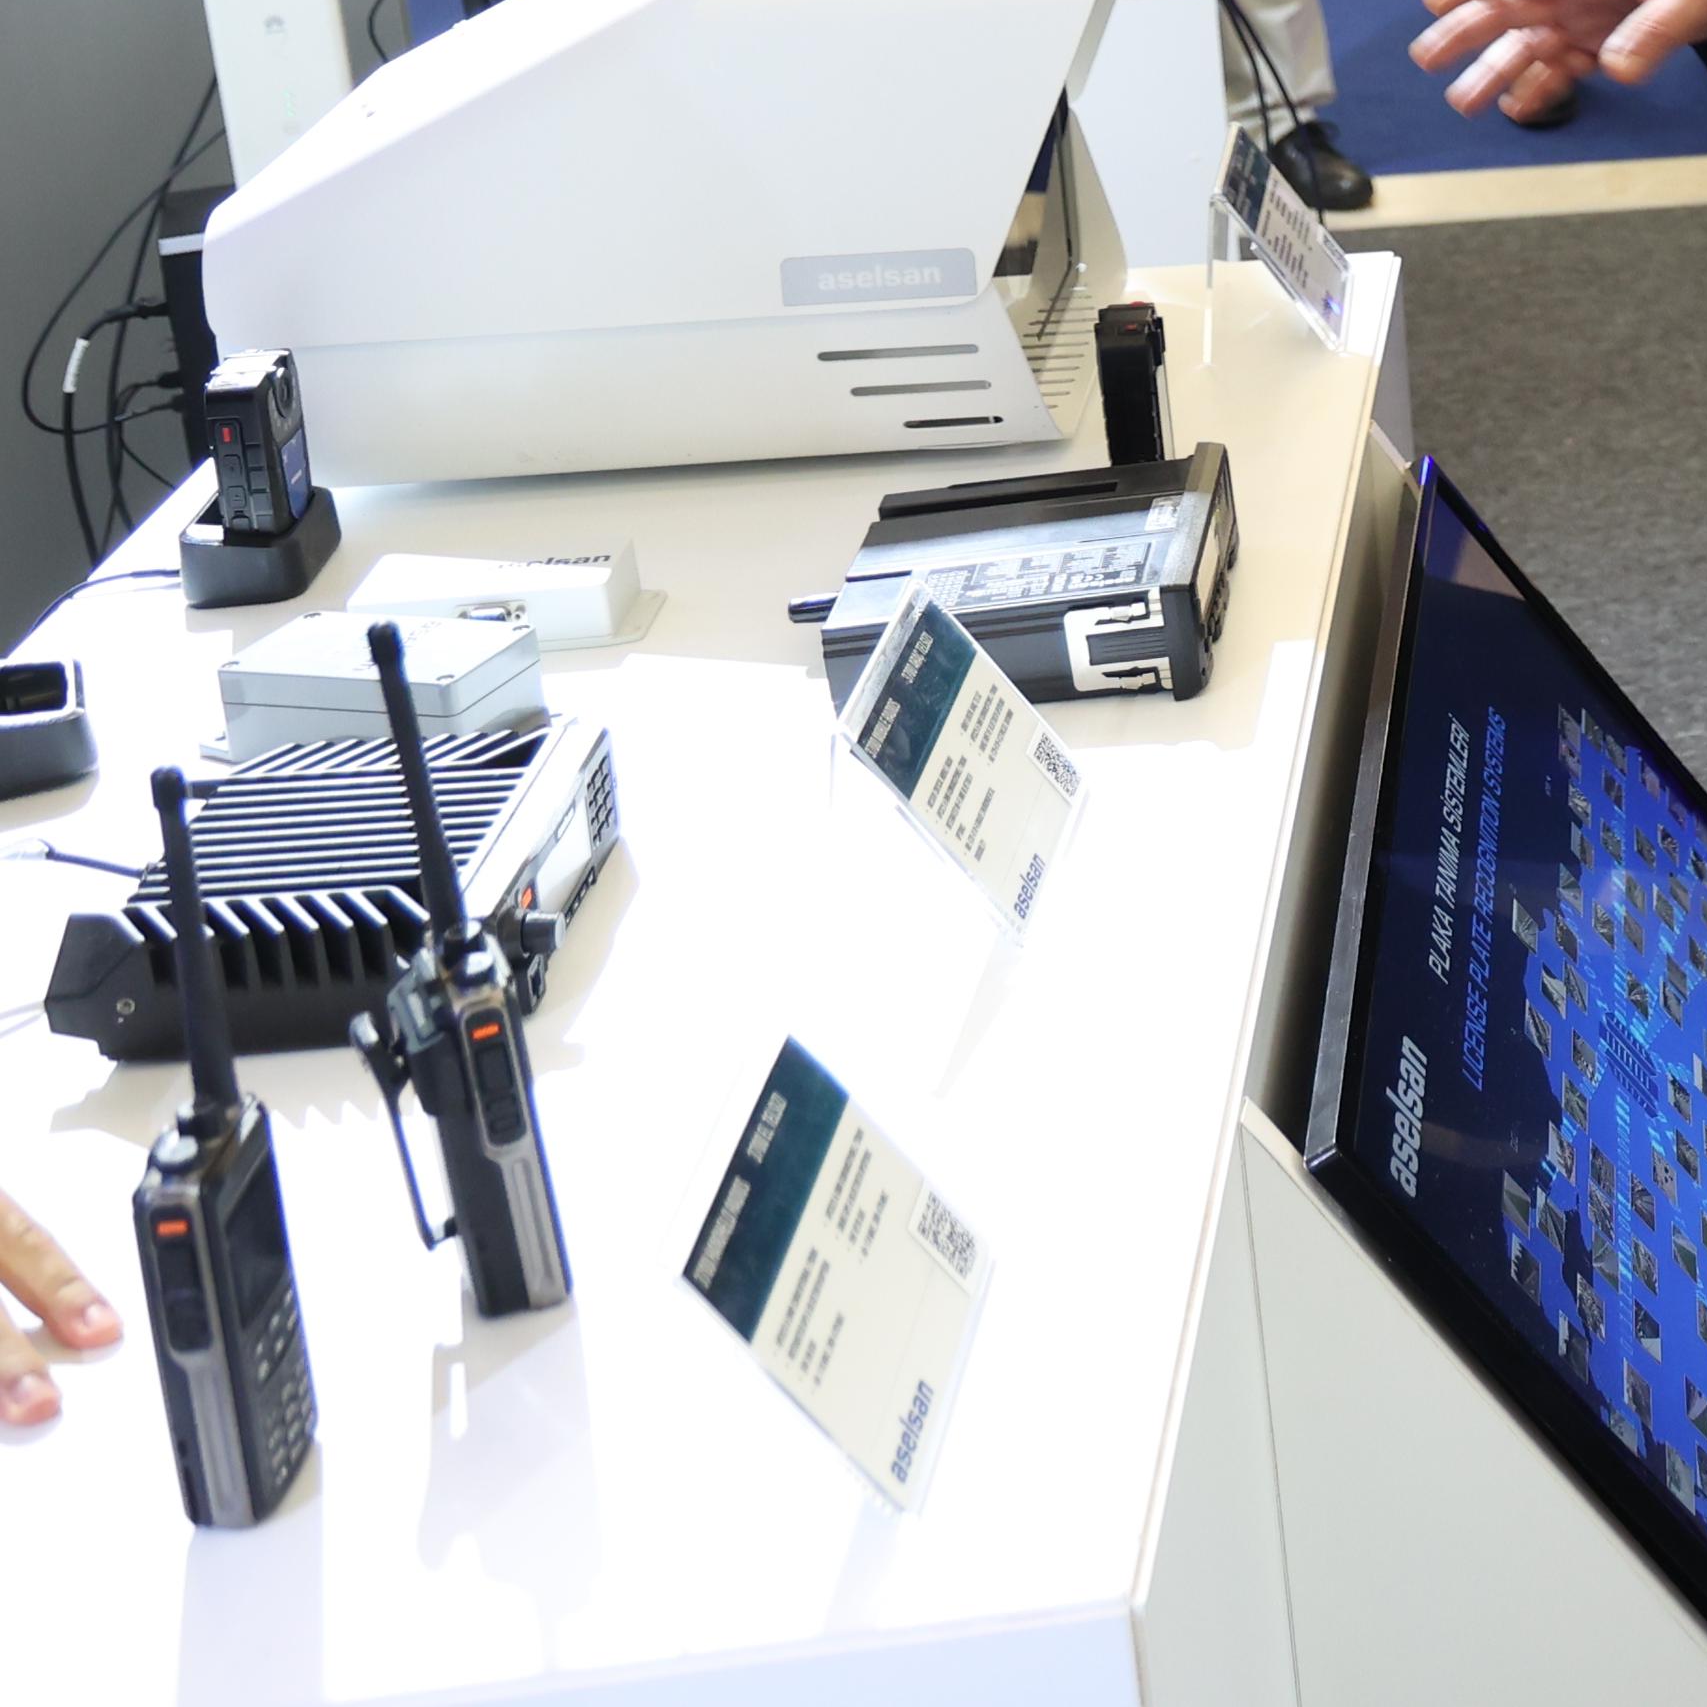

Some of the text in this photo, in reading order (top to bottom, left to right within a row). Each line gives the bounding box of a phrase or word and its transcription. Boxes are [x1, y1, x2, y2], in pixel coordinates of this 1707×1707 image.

[817, 259, 942, 291] aselsan
[1014, 853, 1046, 920] aselsan
[1429, 713, 1471, 985] PLAKA TANIMA SİSTEMLERİ
[1461, 706, 1506, 1091] LICENSE PLATE RECOGNITION SYSTEMS
[1385, 1035, 1428, 1199] aselsan
[890, 1380, 934, 1484] aselsan
